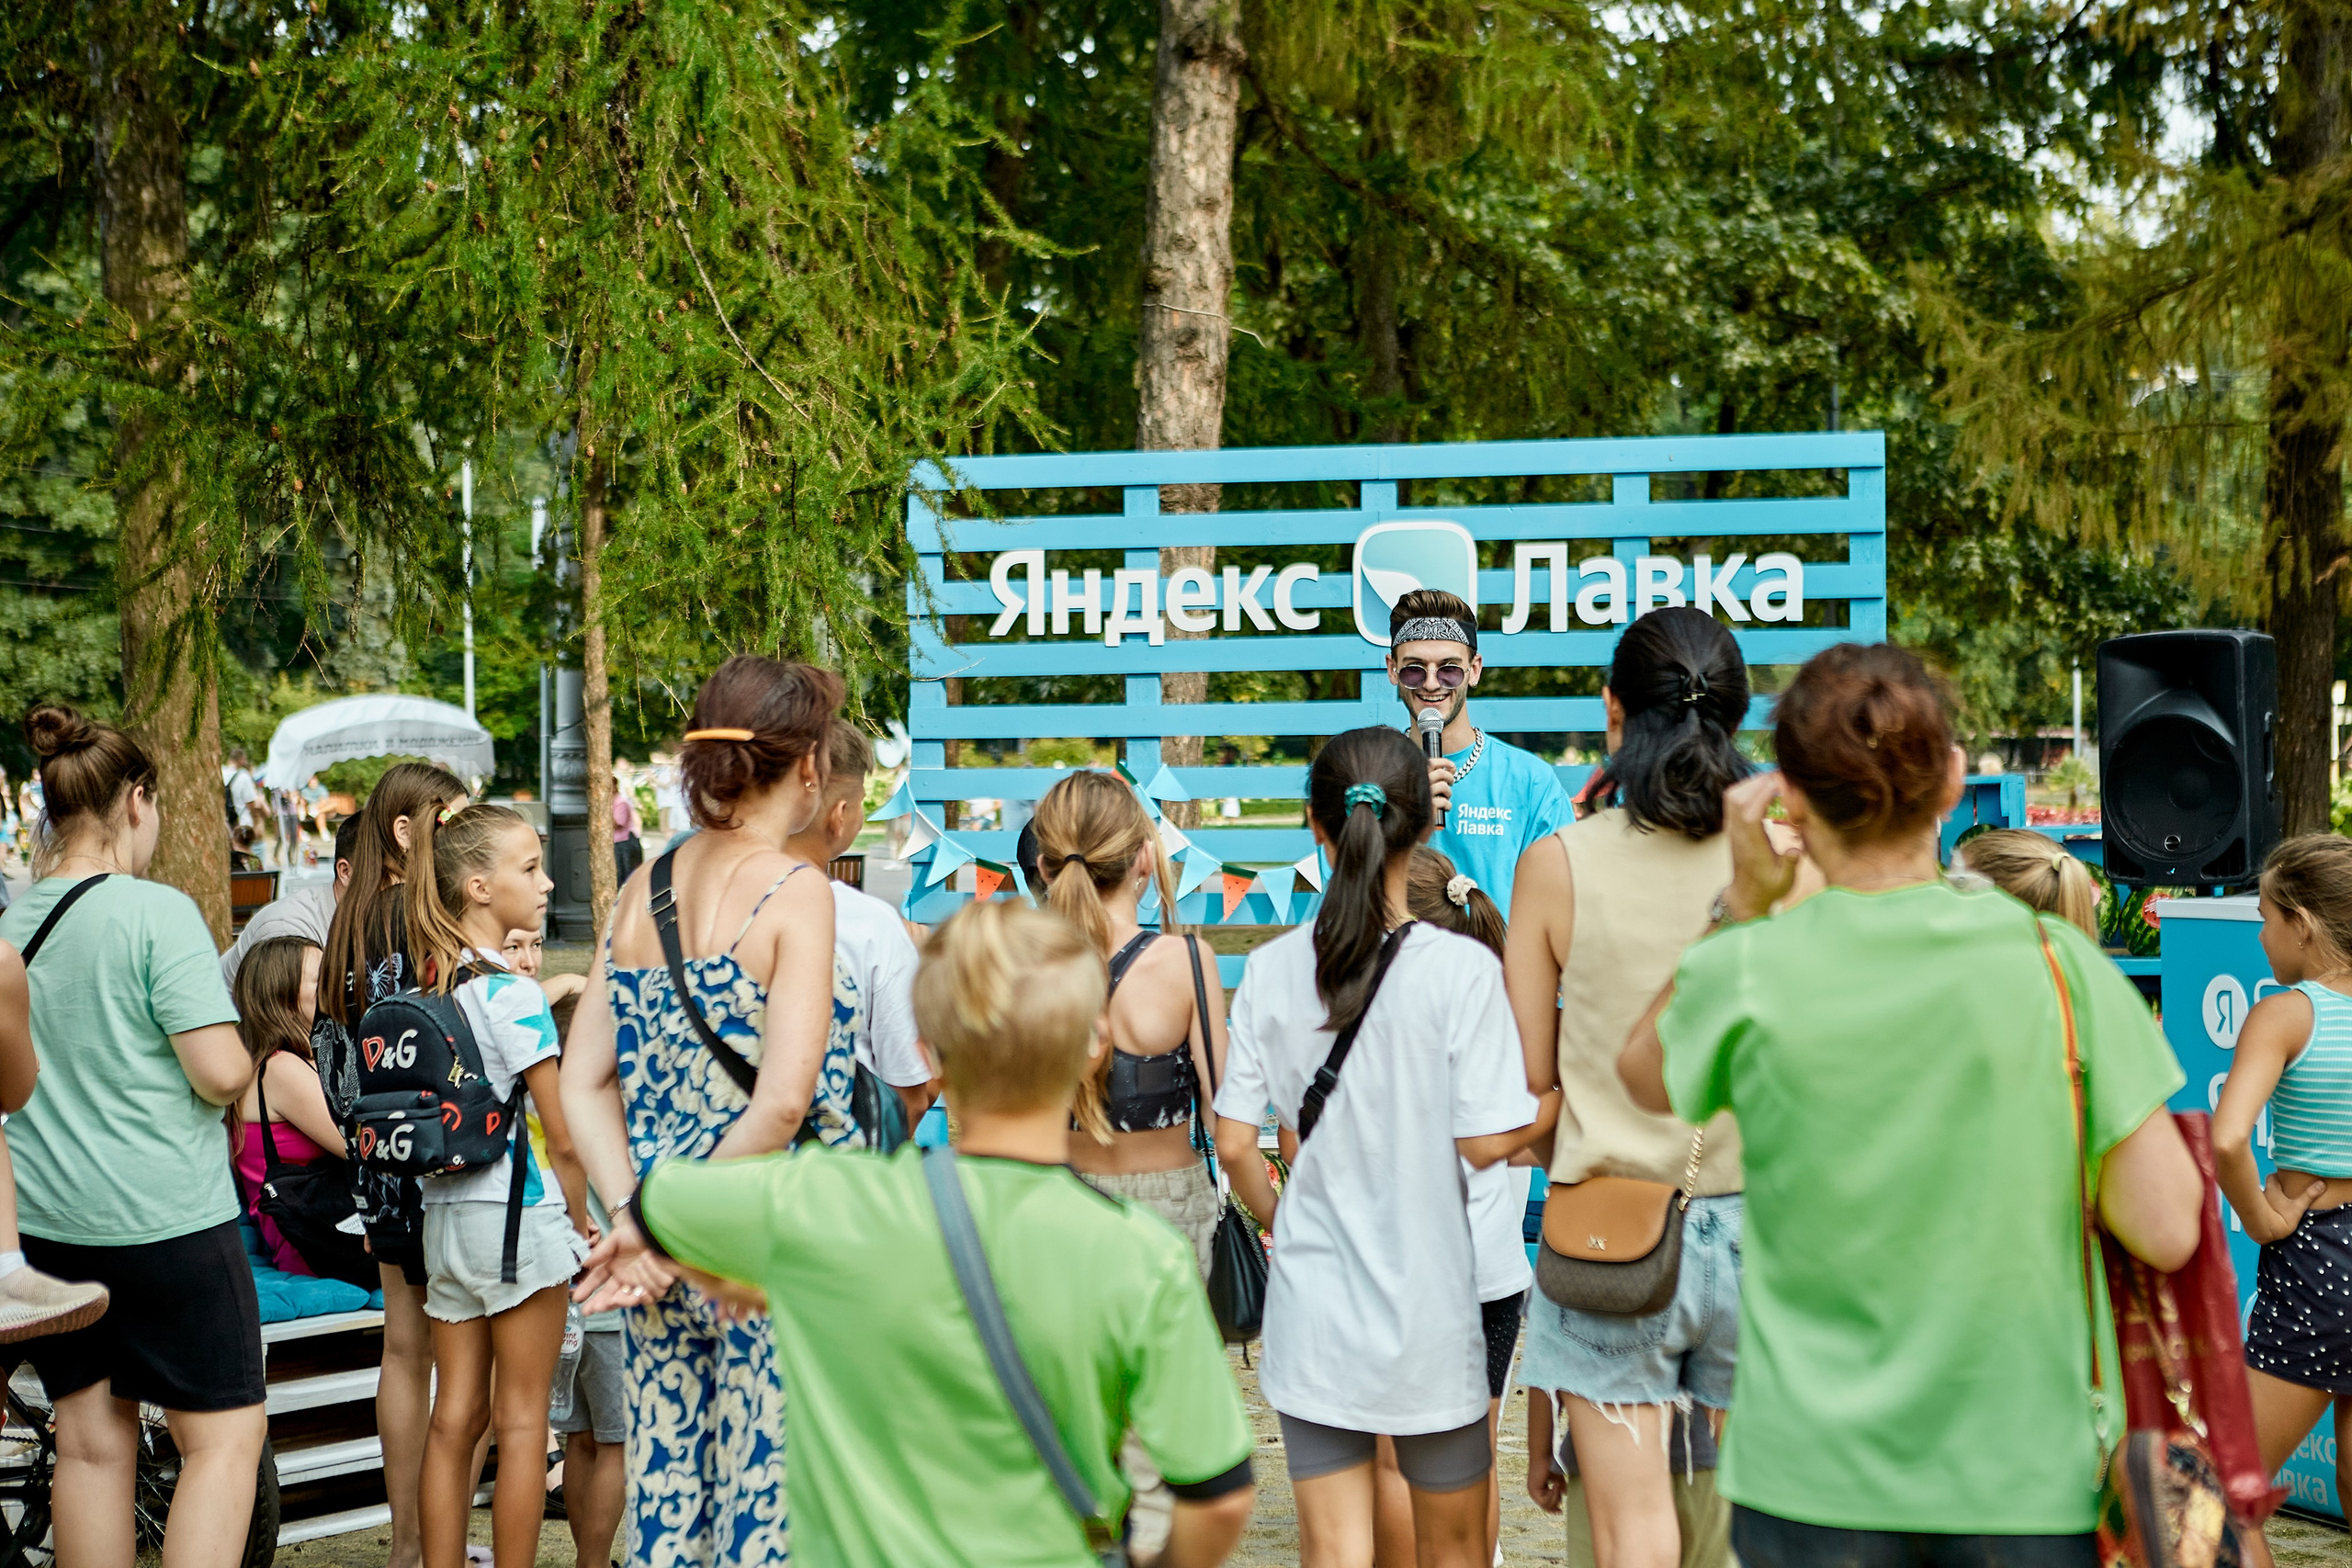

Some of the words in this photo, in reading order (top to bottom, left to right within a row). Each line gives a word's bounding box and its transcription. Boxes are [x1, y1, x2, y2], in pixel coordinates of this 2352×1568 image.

[989, 549, 1320, 648] Яндекс
[1501, 541, 1804, 635] Лавка
[1456, 820, 1504, 836] Лавка
[1457, 803, 1512, 821] Яндекс
[362, 1029, 418, 1073] D&G
[359, 1123, 415, 1162] D&G
[2272, 1468, 2329, 1506] вка
